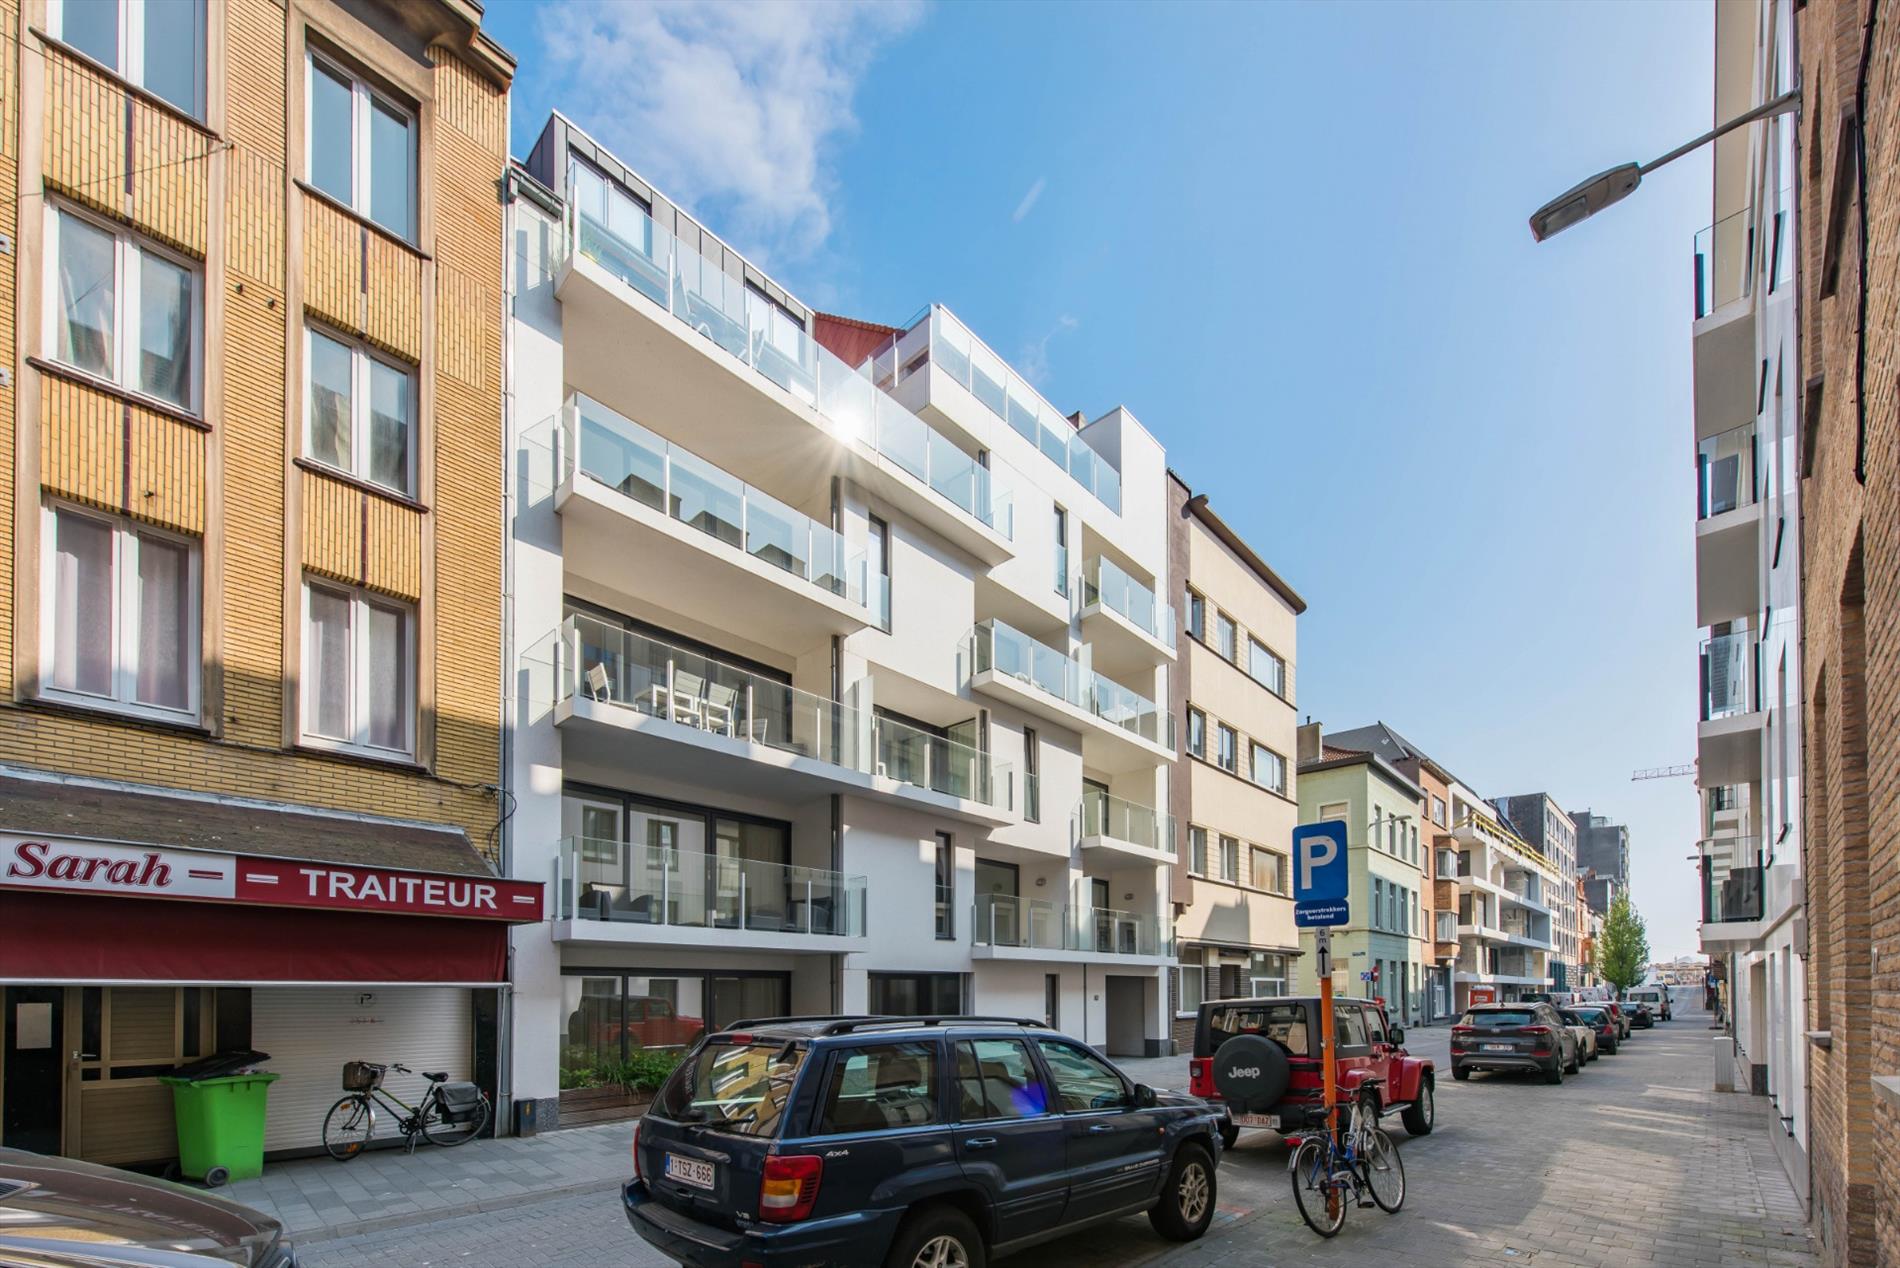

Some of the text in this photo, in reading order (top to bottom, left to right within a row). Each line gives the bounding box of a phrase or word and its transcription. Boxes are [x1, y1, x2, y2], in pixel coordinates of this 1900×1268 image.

[7, 841, 497, 909] Sarah TRAITEUR
[1301, 835, 1337, 889] P
[1228, 1066, 1260, 1079] Jeep
[670, 1159, 712, 1182] 1-TSZ-666
